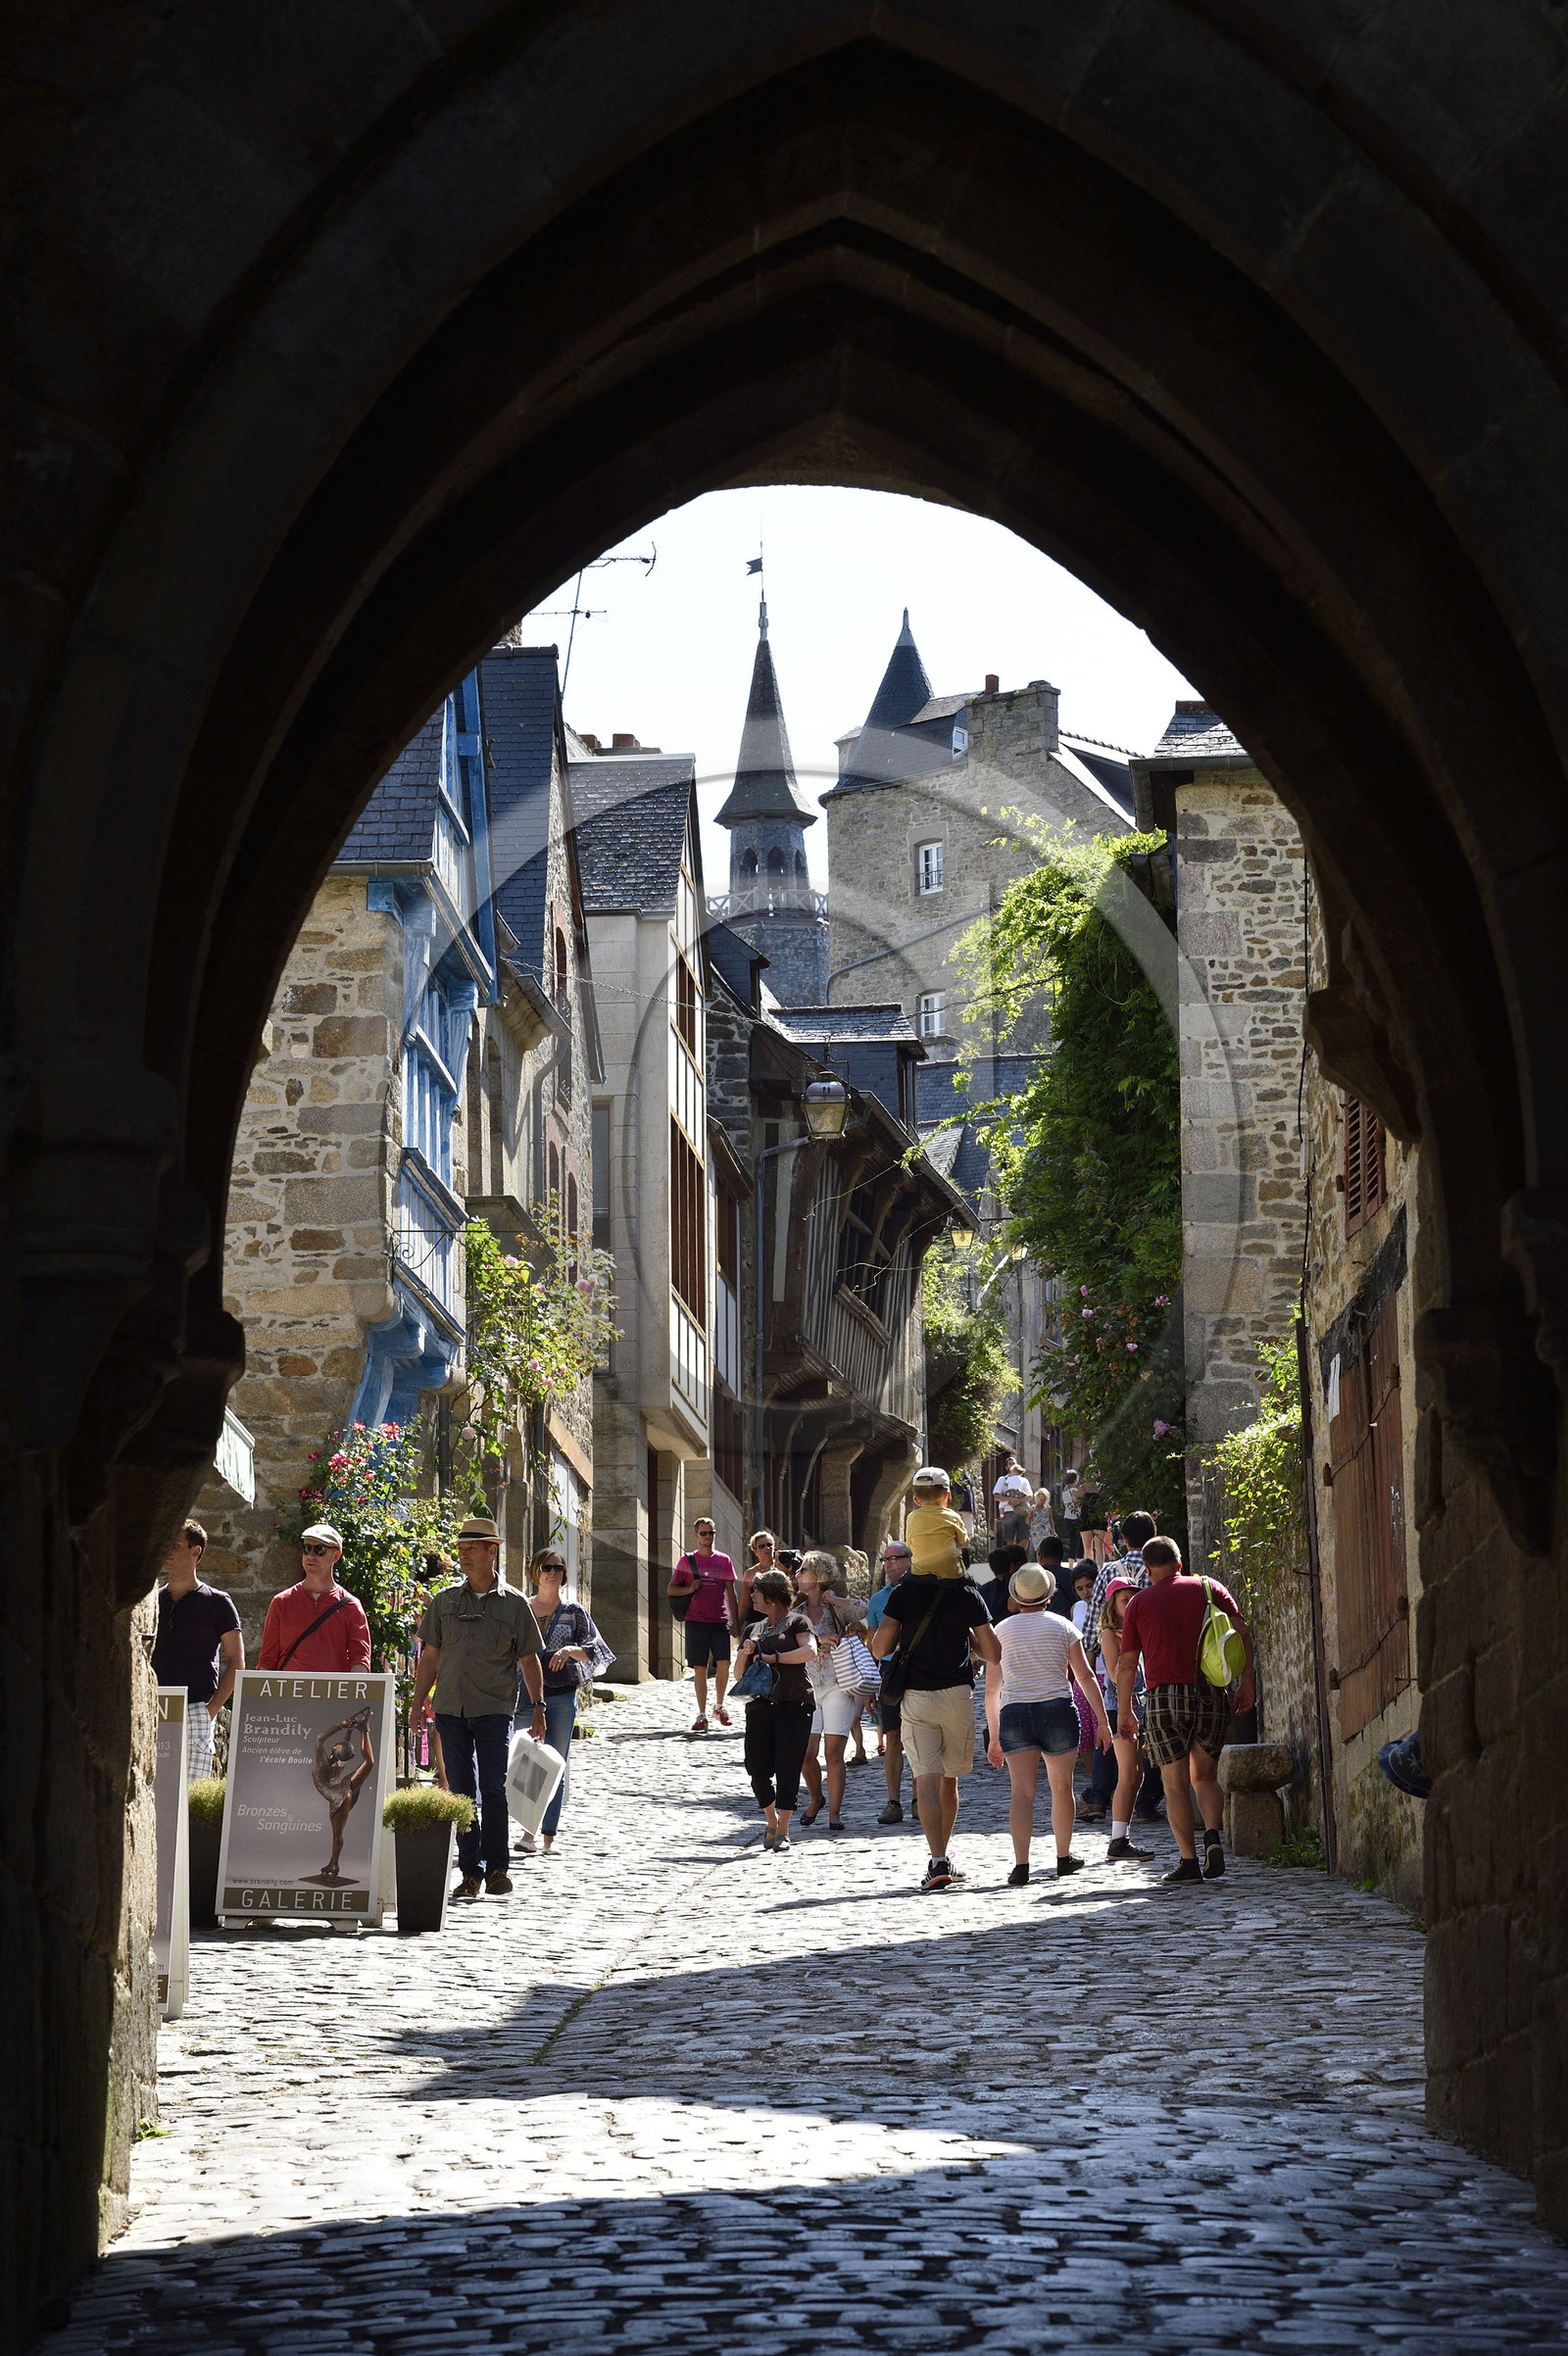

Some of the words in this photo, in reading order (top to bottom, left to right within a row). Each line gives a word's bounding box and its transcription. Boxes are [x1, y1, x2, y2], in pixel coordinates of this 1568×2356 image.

[259, 1679, 368, 1700] ATELIER
[243, 1713, 298, 1724] Jean-Luc
[243, 1723, 312, 1740] Brandily
[243, 1735, 280, 1744] Sculpteur
[269, 1745, 291, 1754] élève
[292, 1746, 303, 1755] de
[260, 1755, 287, 1764] l'école
[288, 1755, 314, 1765] Boulle
[237, 1803, 288, 1817] Bronzes
[257, 1818, 322, 1835] Sanguines
[241, 1890, 353, 1910] GALERIE
